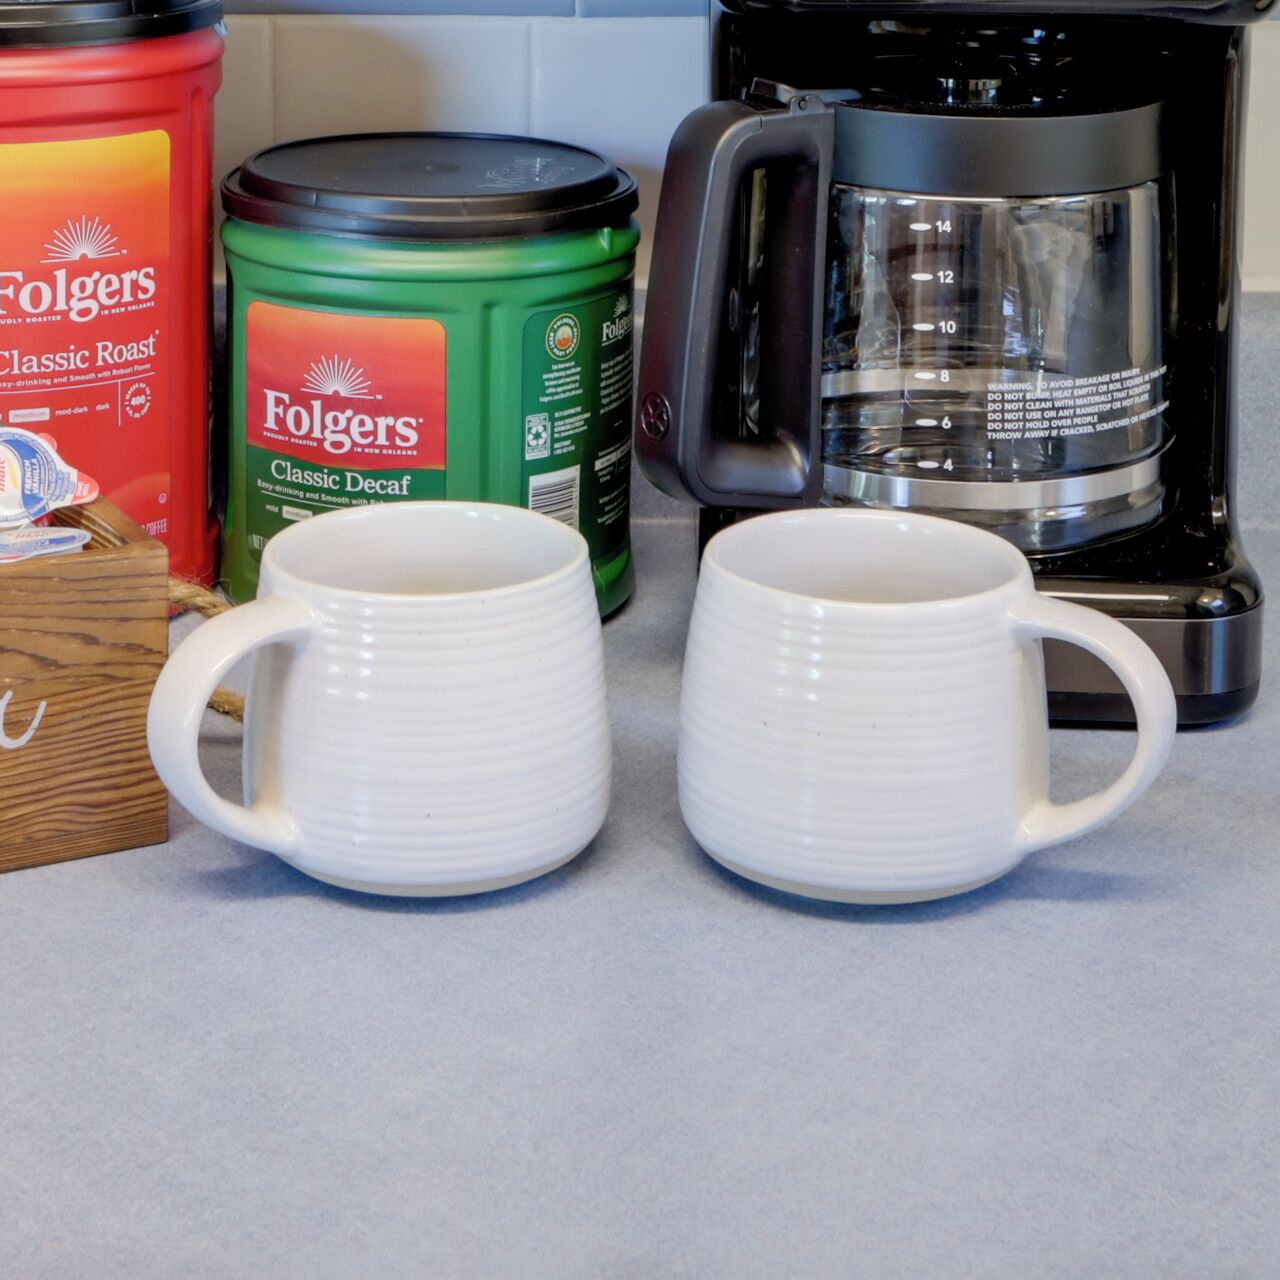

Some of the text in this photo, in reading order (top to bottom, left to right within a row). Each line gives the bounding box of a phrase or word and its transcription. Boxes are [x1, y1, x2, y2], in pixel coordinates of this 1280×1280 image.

[935, 221, 952, 233] 14
[937, 271, 954, 283] 12
[939, 321, 956, 334] 10
[96, 333, 157, 367] Roast
[53, 375, 68, 385] and
[70, 372, 96, 382] Smooth
[97, 369, 111, 379] with
[940, 370, 950, 382] 8
[987, 382, 1034, 391] WARNING,
[1049, 379, 1074, 388] AVOID
[1075, 374, 1111, 386] BREAKAGE
[987, 393, 1002, 401] DO
[1004, 392, 1024, 400] NOT
[1053, 390, 1072, 398] HEAT
[1074, 386, 1096, 396] EMPTY
[1098, 384, 1107, 392] OR
[130, 395, 147, 406] 400
[987, 403, 1002, 411] DO
[1004, 402, 1024, 410] NOT
[1026, 401, 1052, 410] CLEAN
[1054, 399, 1074, 408] WITH
[1076, 394, 1112, 406] MATERIALS
[55, 406, 88, 417] med-dark
[95, 403, 110, 412] dark
[13, 410, 47, 420] medium
[263, 389, 419, 454] Folgers
[987, 413, 1002, 421] DO
[1004, 412, 1024, 420] NOT
[1026, 411, 1042, 419] USE
[1044, 411, 1056, 419] ON
[1058, 409, 1074, 417] ANY
[942, 416, 952, 429] 6
[987, 415, 1098, 430] DO NOT HOLD OVER PEOPLE
[987, 431, 1023, 440] THROW
[1024, 430, 1050, 438] AWAY
[1051, 429, 1058, 437] IF
[1060, 426, 1094, 437] CRACKED,
[943, 459, 954, 471] 4
[23, 459, 32, 494] FRENCH
[30, 458, 40, 494] VANILLA
[271, 459, 412, 495] Classic Decaf
[257, 479, 304, 498] Easy-drinking
[305, 492, 320, 500] and
[320, 494, 350, 505] Smooth
[351, 497, 369, 506] with
[265, 504, 279, 513] mild
